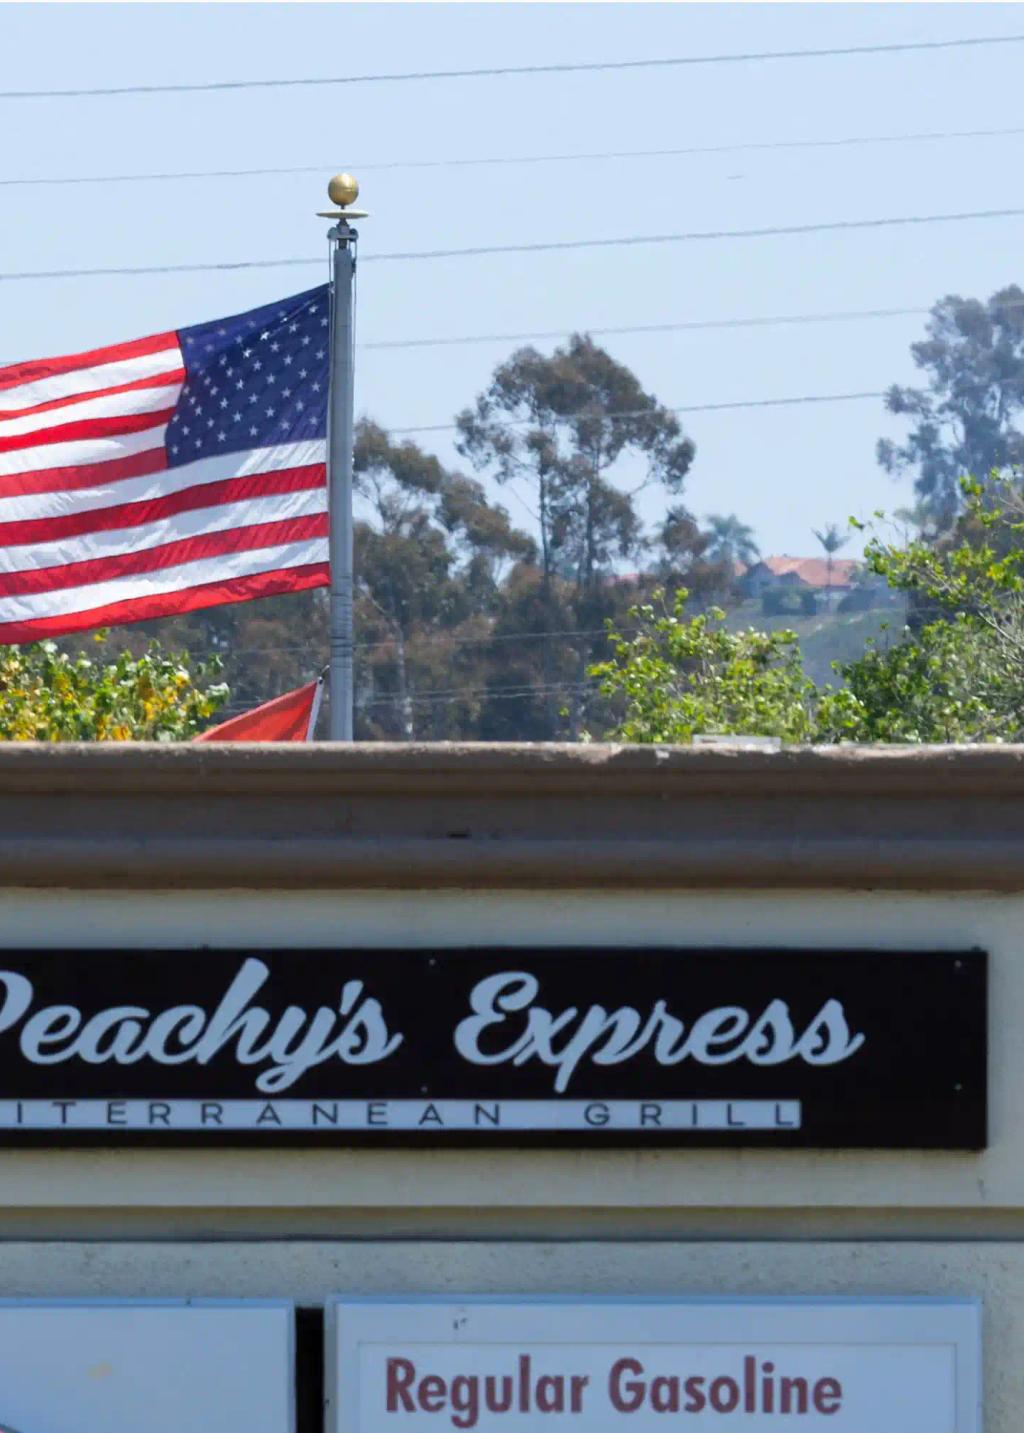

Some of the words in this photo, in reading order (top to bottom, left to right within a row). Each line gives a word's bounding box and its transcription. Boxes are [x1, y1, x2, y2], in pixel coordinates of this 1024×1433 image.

[453, 971, 865, 1093] Express
[583, 1104, 795, 1126] GRILL
[385, 1354, 590, 1429] Regular
[608, 1354, 843, 1416] Gasoline
